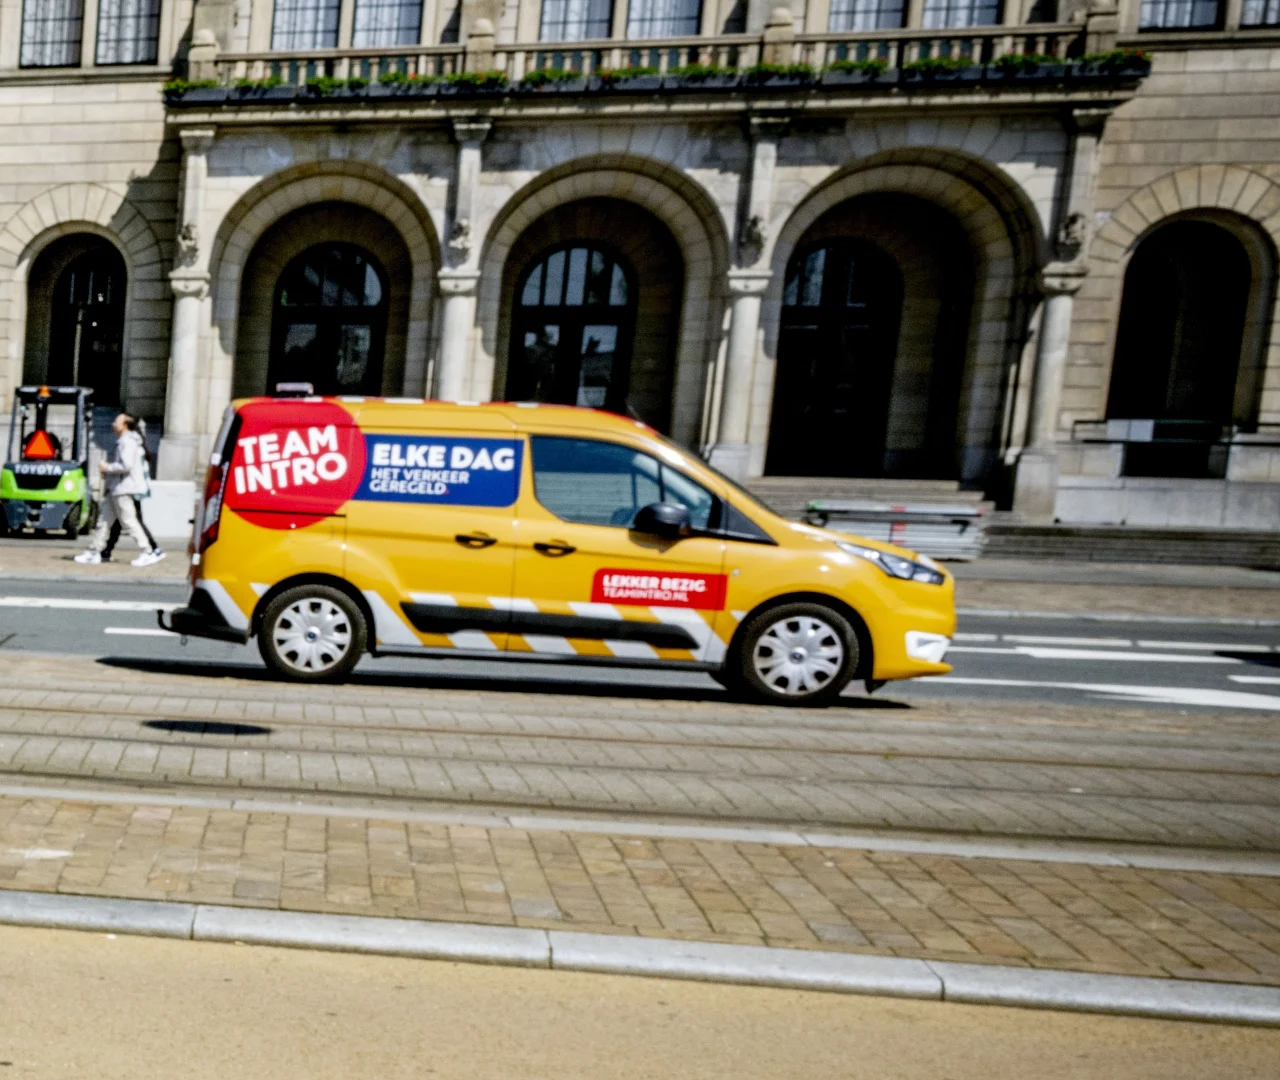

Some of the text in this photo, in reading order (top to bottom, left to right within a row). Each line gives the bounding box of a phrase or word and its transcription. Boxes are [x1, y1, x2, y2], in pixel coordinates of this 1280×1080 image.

[238, 424, 338, 464] TEAM
[372, 443, 515, 471] ELKE DAG
[14, 464, 62, 476] TOYOTA
[234, 452, 348, 494] INTRO
[371, 467, 470, 484] HET VERKEER
[603, 574, 659, 589] LEKKER
